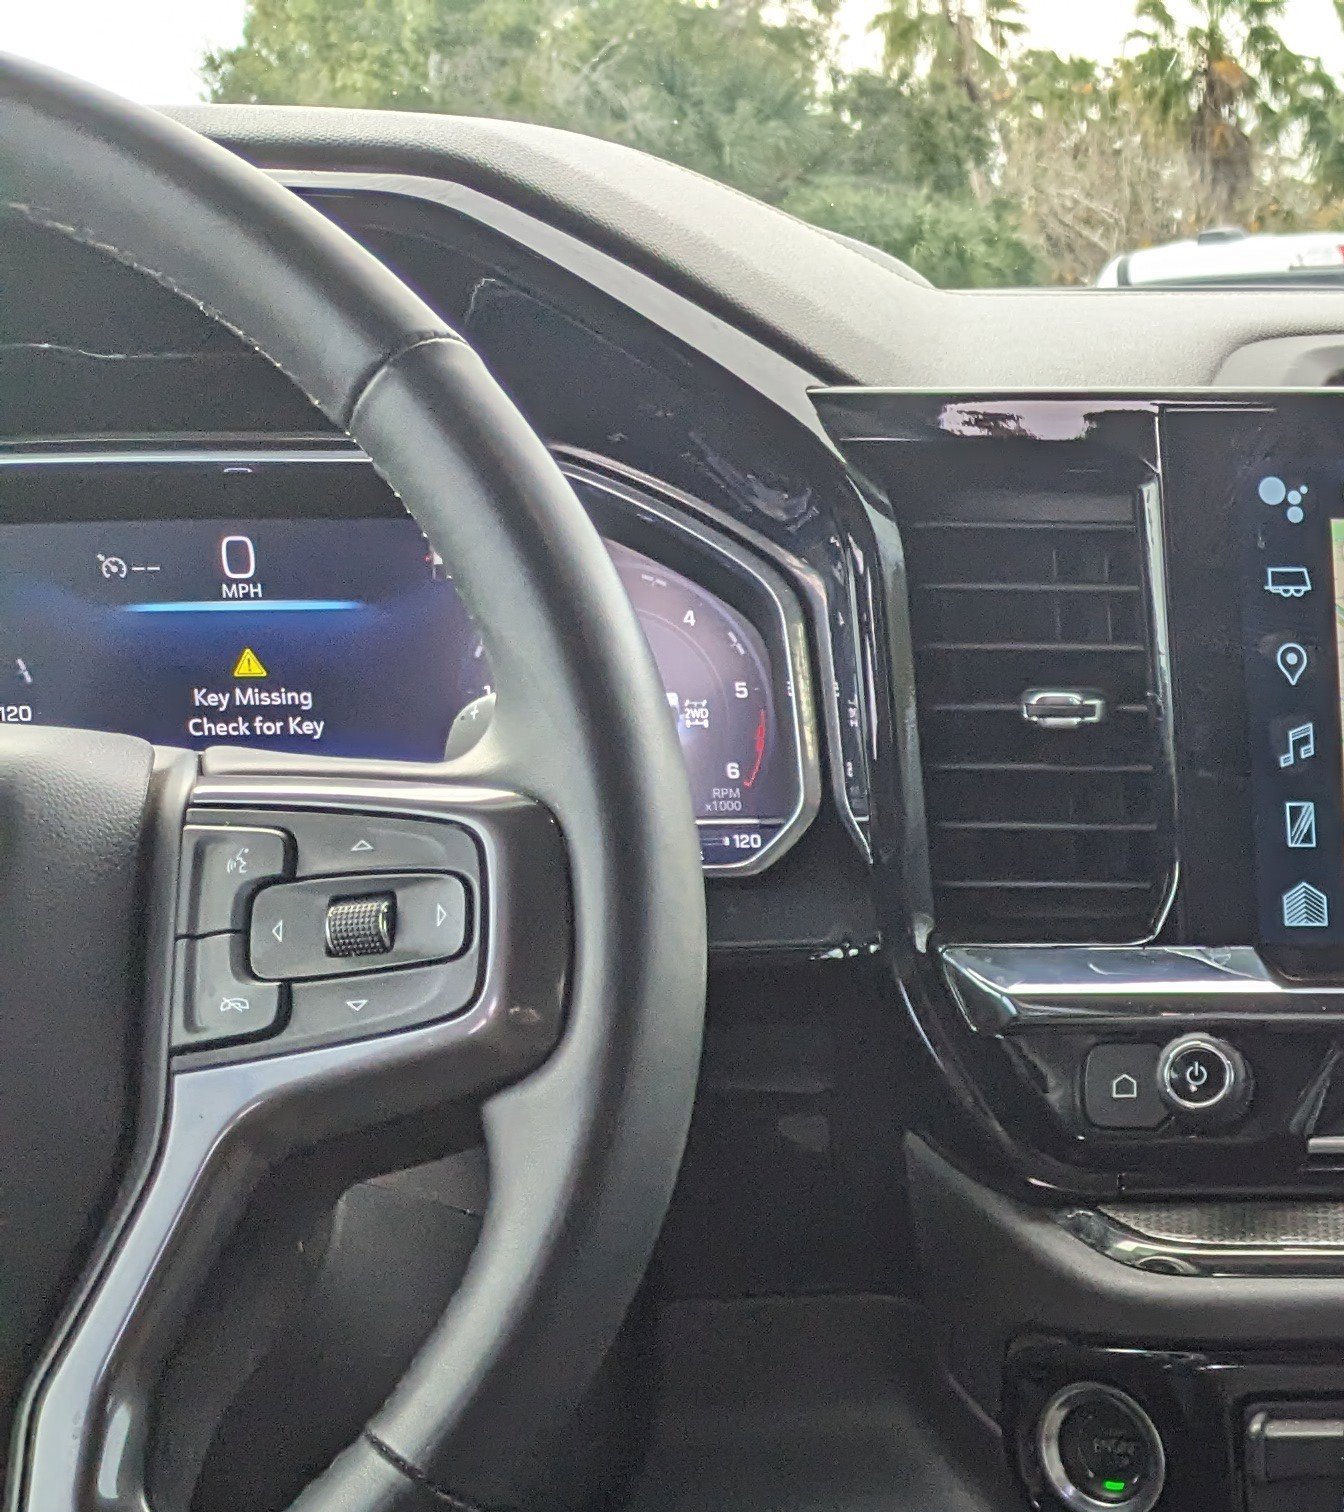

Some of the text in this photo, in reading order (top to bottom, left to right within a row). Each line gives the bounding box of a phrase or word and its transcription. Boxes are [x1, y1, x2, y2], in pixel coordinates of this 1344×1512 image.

[221, 535, 256, 579] 0
[222, 583, 263, 598] MPH
[683, 610, 696, 626] 4
[735, 681, 748, 698] 5
[193, 687, 313, 711] Key Missing
[685, 707, 709, 719] 2WD
[188, 716, 325, 739] Check for Key
[726, 762, 740, 779] 6
[712, 788, 741, 799] RPM
[706, 800, 742, 812] x1000
[732, 833, 762, 849] 120
